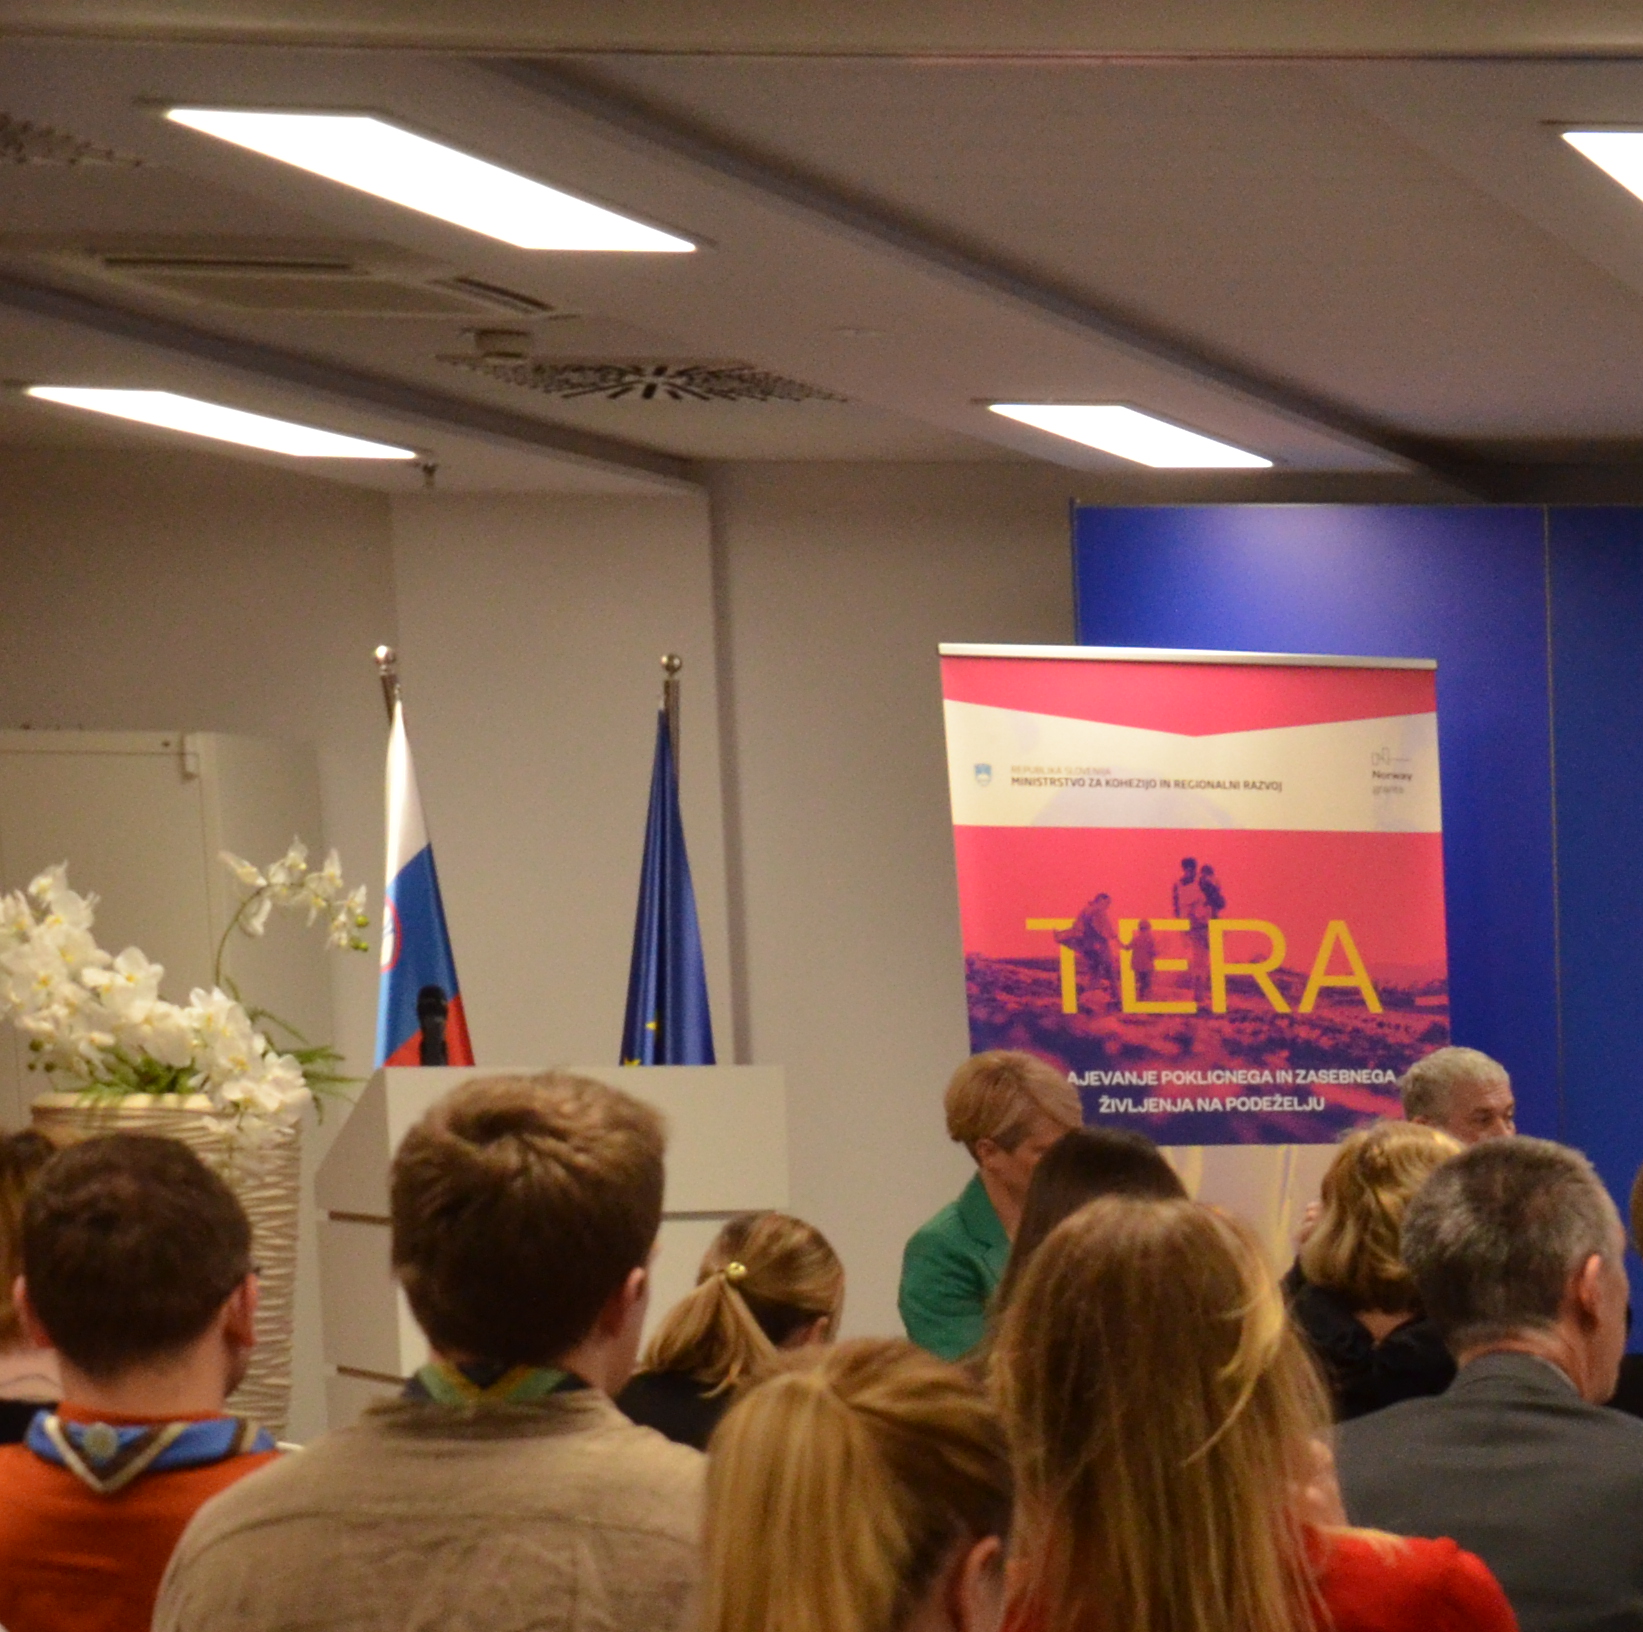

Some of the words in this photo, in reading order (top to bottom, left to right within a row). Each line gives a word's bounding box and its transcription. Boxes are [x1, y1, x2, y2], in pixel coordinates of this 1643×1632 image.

[1010, 776, 1085, 788] MINISTRSTVO
[1088, 778, 1102, 788] ZA
[1105, 779, 1157, 790] KOHEZIJO
[1159, 780, 1171, 789] IN
[1173, 779, 1241, 790] REGIONALNI
[1243, 781, 1283, 792] RAZVOJ
[1371, 769, 1413, 781] Norway
[1025, 917, 1384, 1014] TERA
[1066, 1069, 1159, 1086] AJEVANJE
[1161, 1069, 1273, 1086] POKLICNEGA
[1275, 1070, 1293, 1085] IN
[1295, 1068, 1396, 1085] ZASEBNEGA
[1099, 1094, 1194, 1114] ŽIVLJENJA
[1197, 1097, 1223, 1113] NA
[1226, 1093, 1325, 1112] PODEŽELJU
